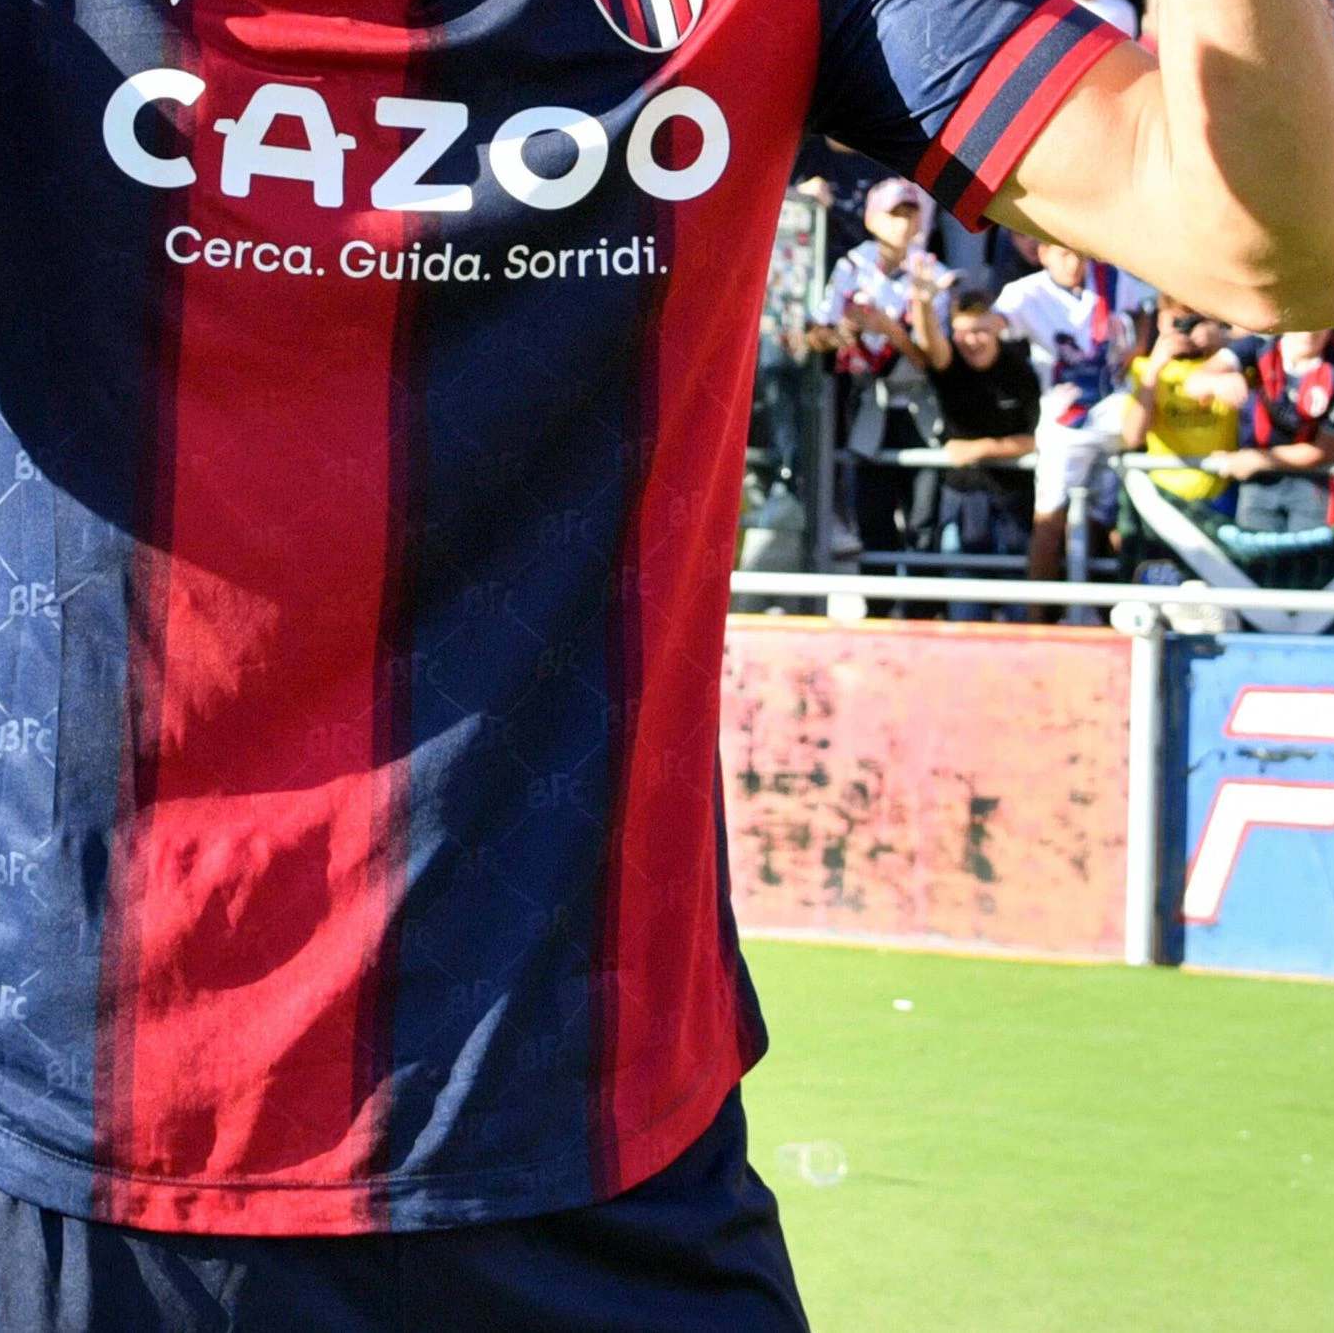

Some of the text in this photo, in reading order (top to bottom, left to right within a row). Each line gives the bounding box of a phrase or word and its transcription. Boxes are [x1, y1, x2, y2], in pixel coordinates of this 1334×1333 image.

[102, 67, 731, 212] CAZOO
[164, 225, 668, 282] Cerca. Guida. Sorridi.
